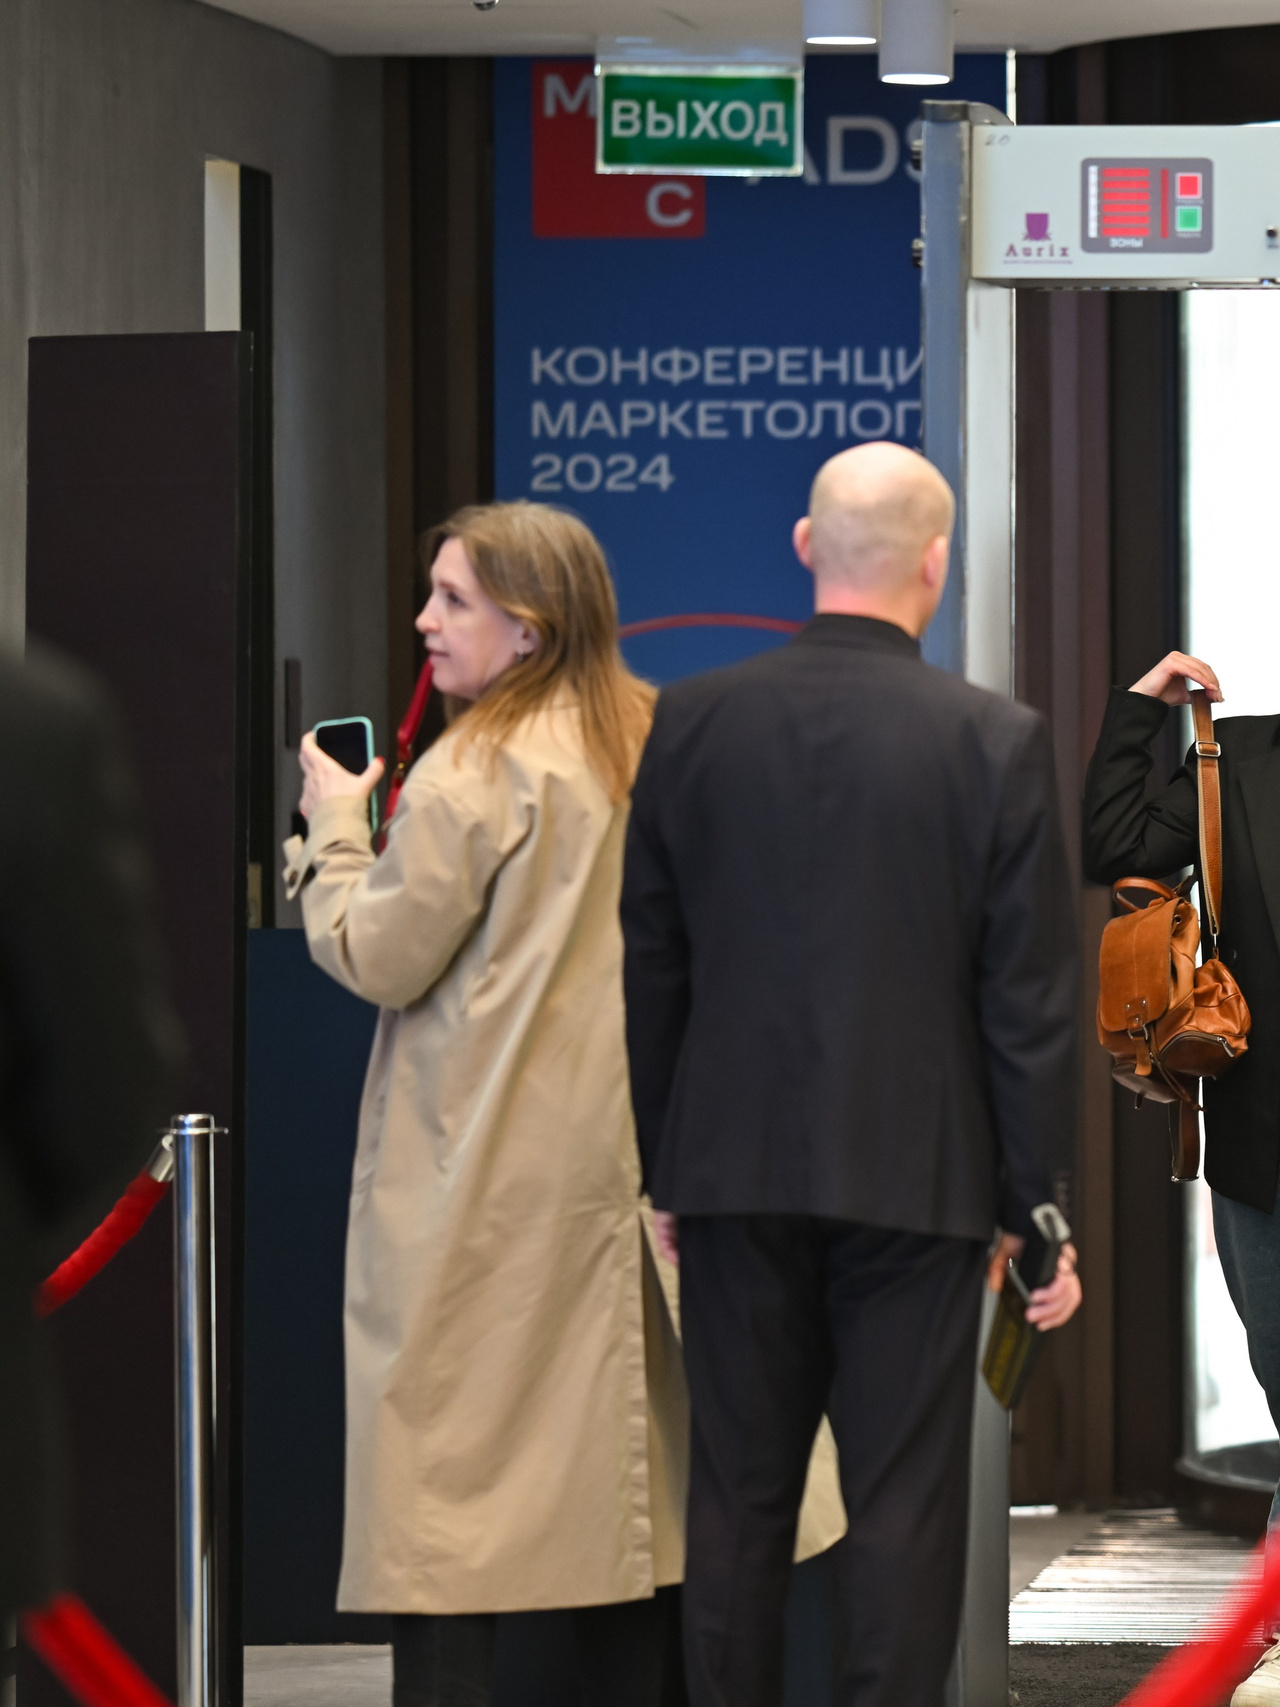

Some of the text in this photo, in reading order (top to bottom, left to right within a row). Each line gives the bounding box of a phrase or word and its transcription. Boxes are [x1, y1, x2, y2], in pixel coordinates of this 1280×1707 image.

[610, 101, 788, 146] ВЫХОД
[1005, 244, 1069, 257] Aurix
[531, 347, 923, 391] КОНФЕРЕНЦИ
[531, 400, 924, 439] МАРКЕТОЛОГ
[531, 453, 674, 492] 2024
